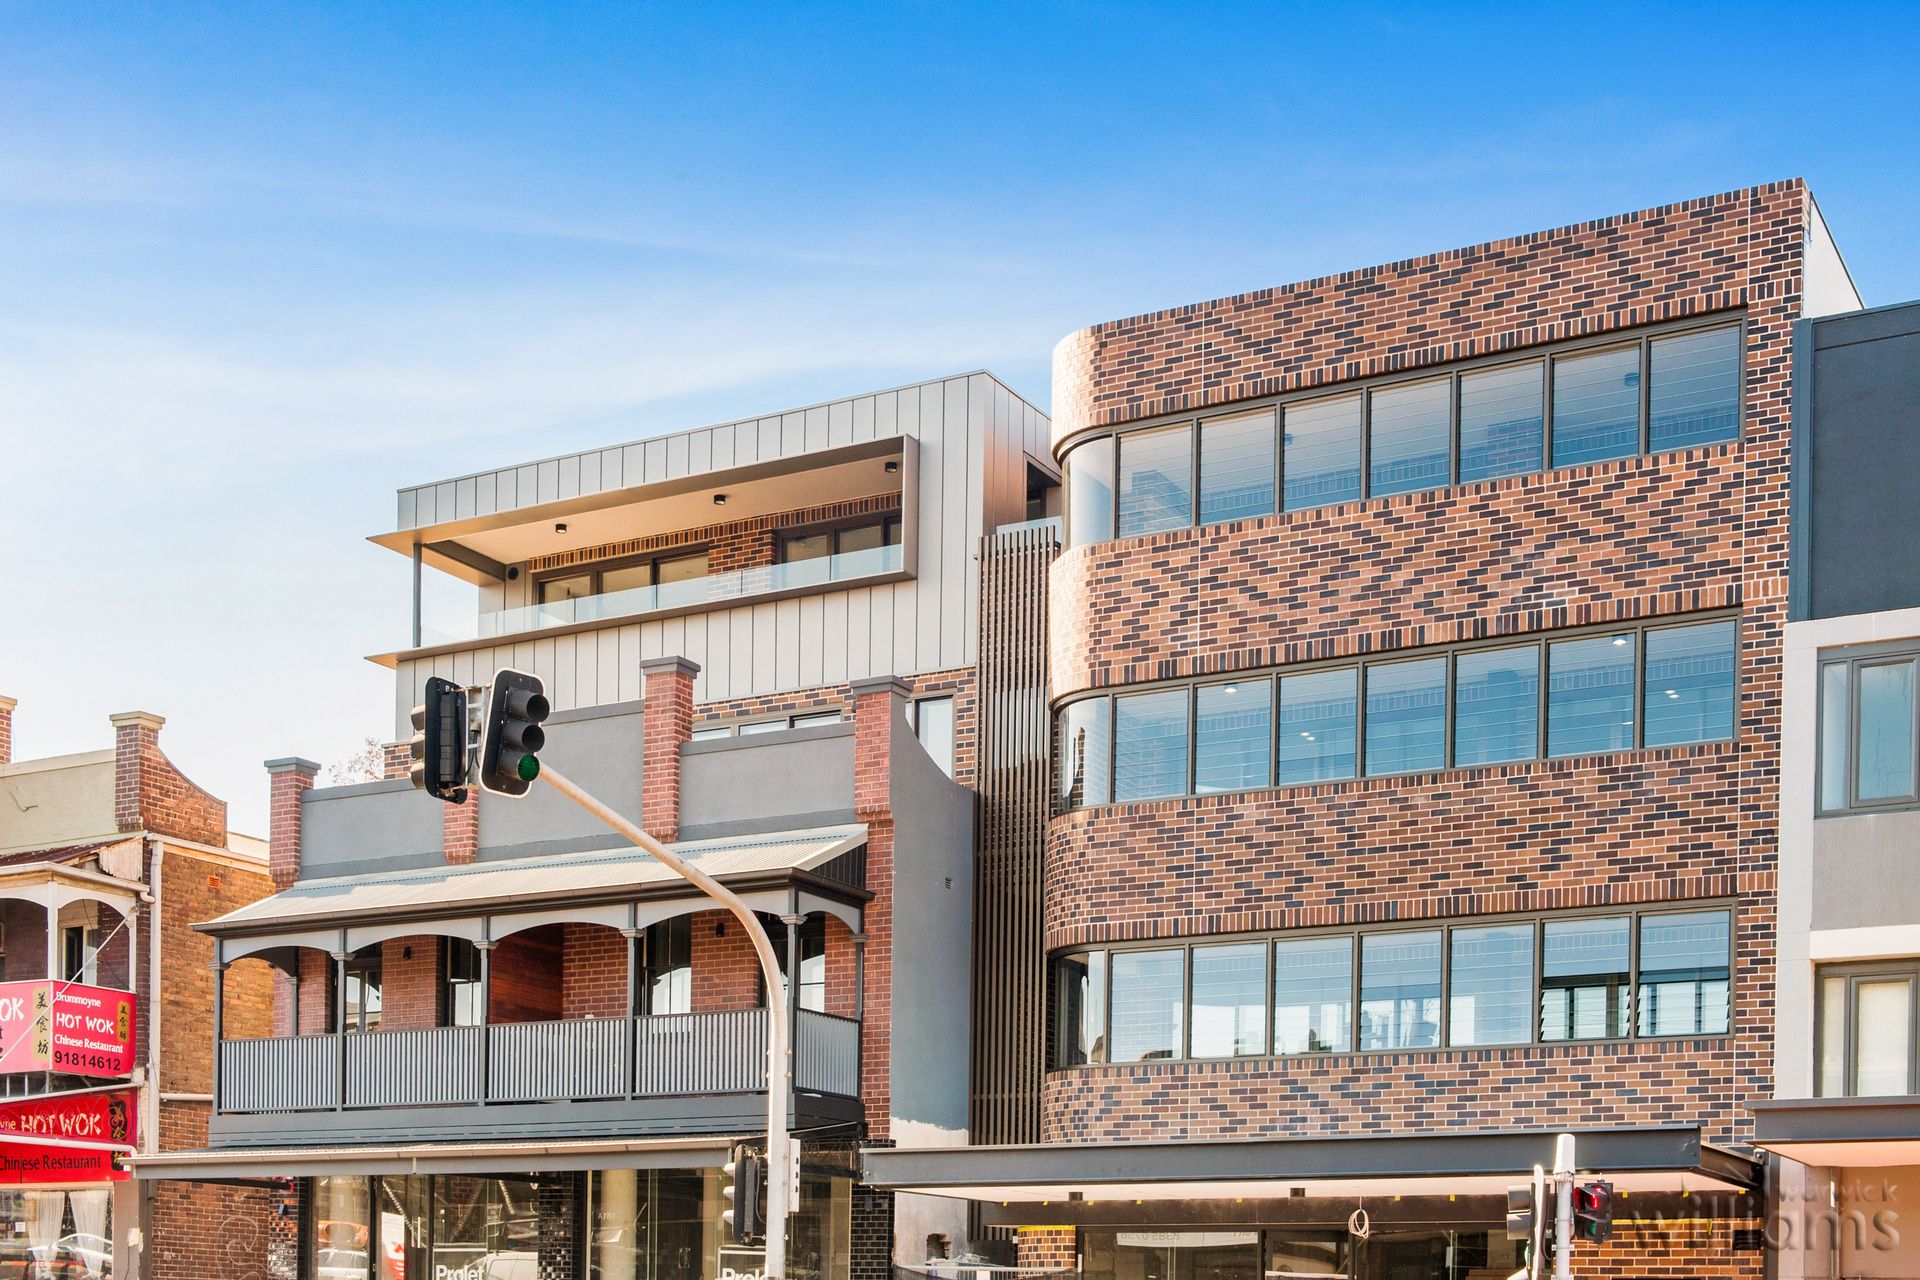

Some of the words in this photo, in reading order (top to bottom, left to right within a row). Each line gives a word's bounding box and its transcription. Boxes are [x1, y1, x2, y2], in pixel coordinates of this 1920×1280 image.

[56, 1012, 82, 1030] HOT
[86, 1016, 114, 1035] WOK
[54, 1034, 83, 1047] Chinese
[84, 1038, 124, 1054] Restaurant
[54, 1051, 121, 1071] 91814612
[21, 1114, 55, 1135] HOT
[59, 1113, 101, 1136] WOK
[42, 1154, 101, 1169] Restaurant
